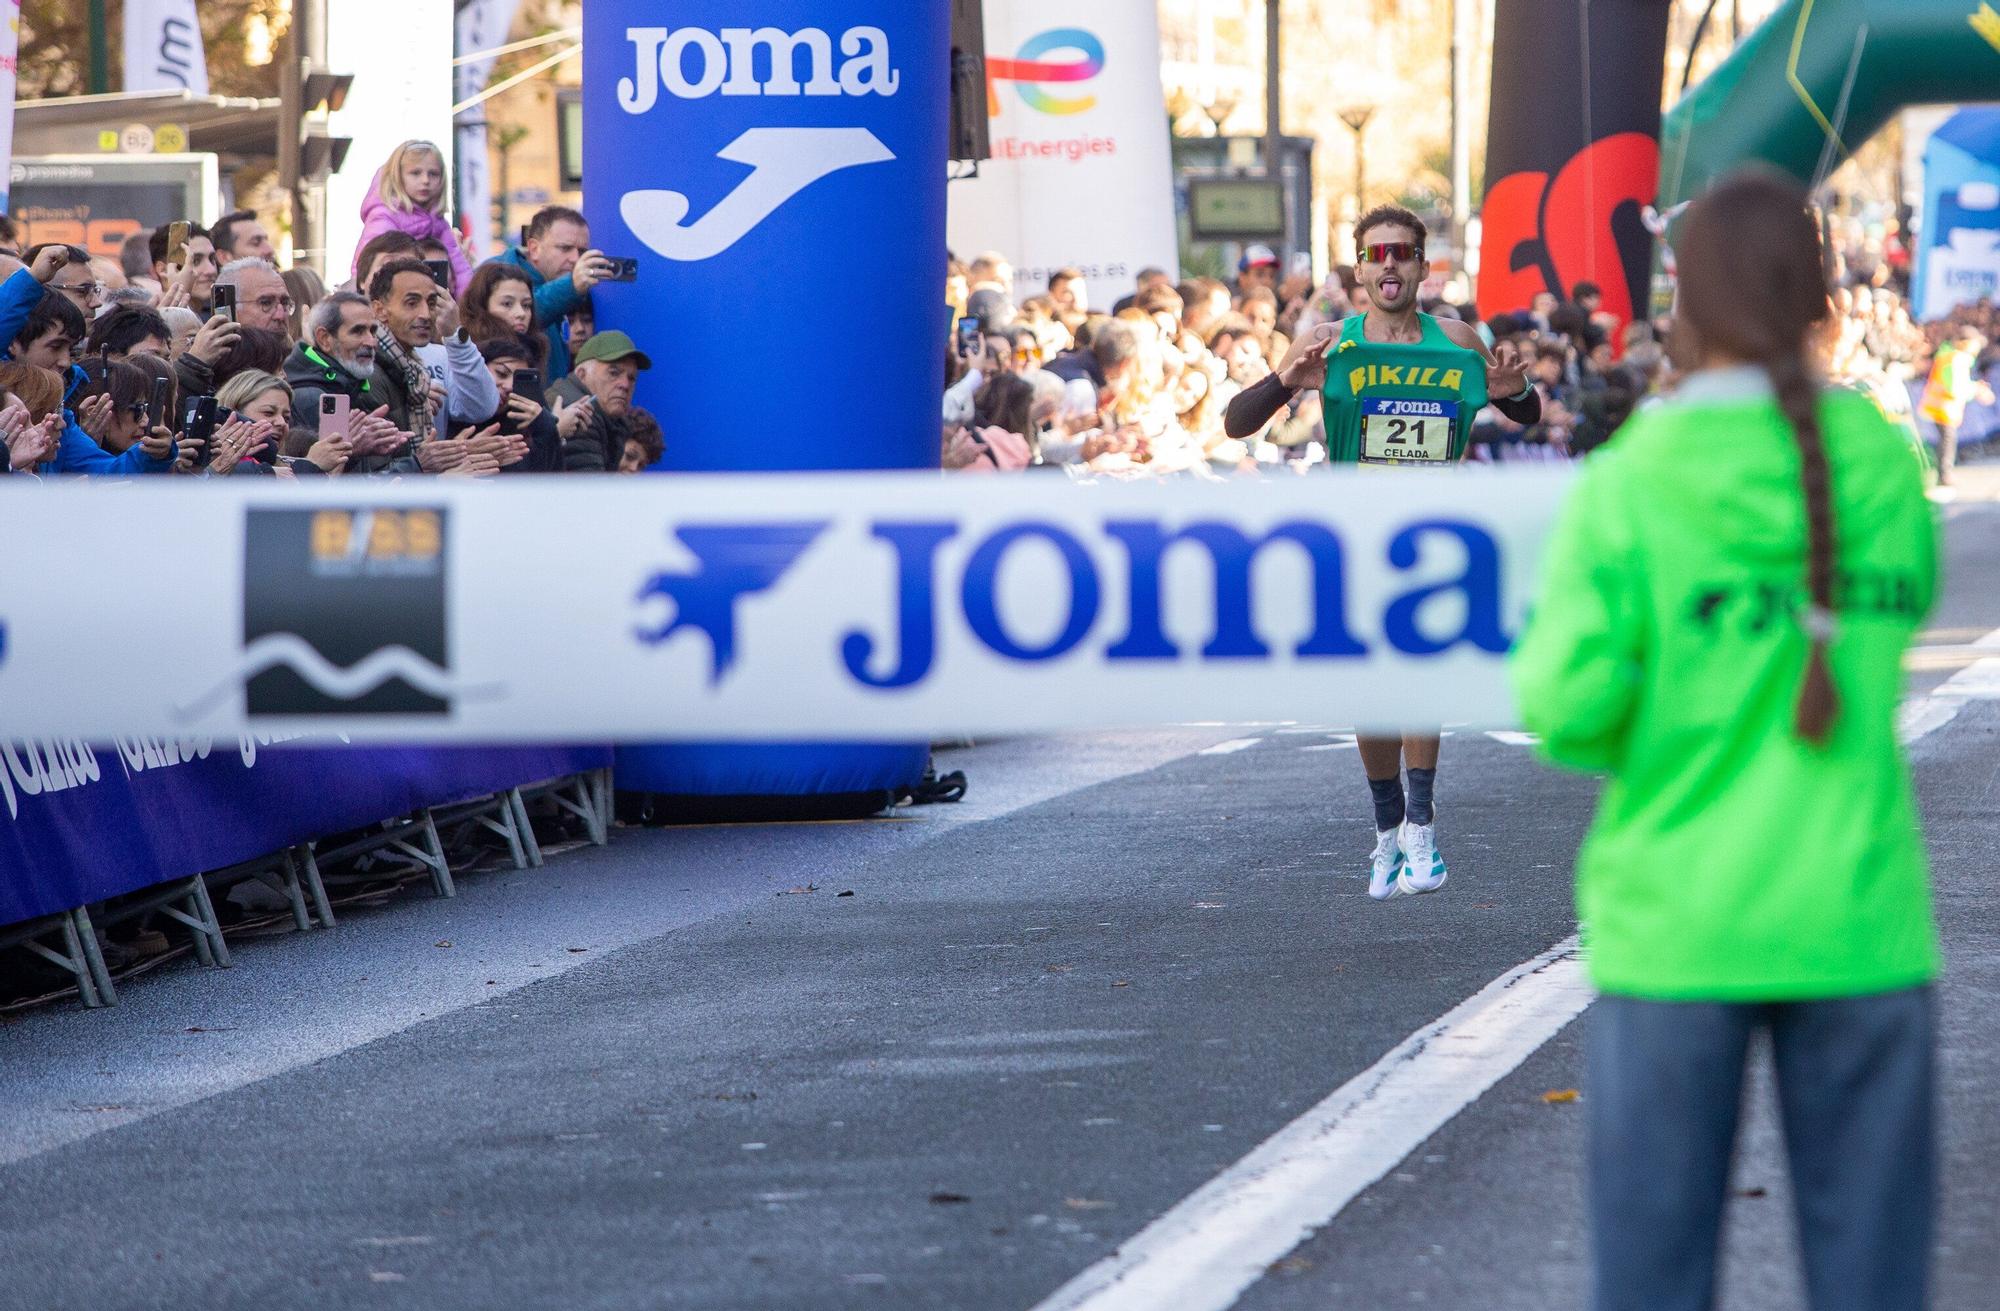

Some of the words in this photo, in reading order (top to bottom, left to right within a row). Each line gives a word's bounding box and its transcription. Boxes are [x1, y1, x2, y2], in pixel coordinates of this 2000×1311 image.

[617, 26, 899, 114] Joma
[991, 133, 1116, 163] lEnergies
[1349, 364, 1463, 396] BIKILA
[1386, 419, 1425, 445] 21
[1384, 448, 1429, 459] CELADA
